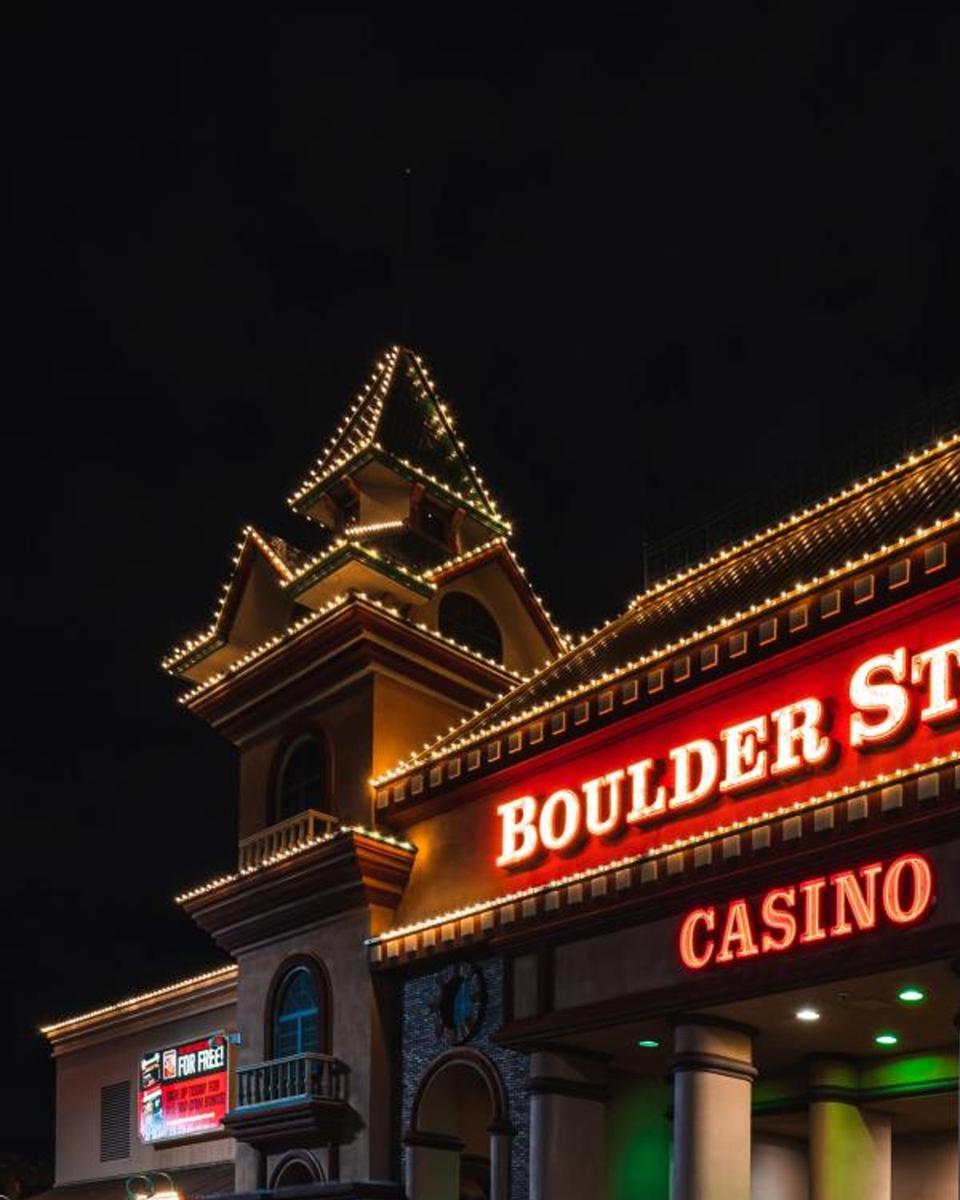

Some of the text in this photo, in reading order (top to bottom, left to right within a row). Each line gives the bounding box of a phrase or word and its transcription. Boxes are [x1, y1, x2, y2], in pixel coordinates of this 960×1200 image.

[496, 697, 829, 867] BOULDER
[679, 854, 931, 969] CASINO
[178, 1054, 196, 1077] FOR
